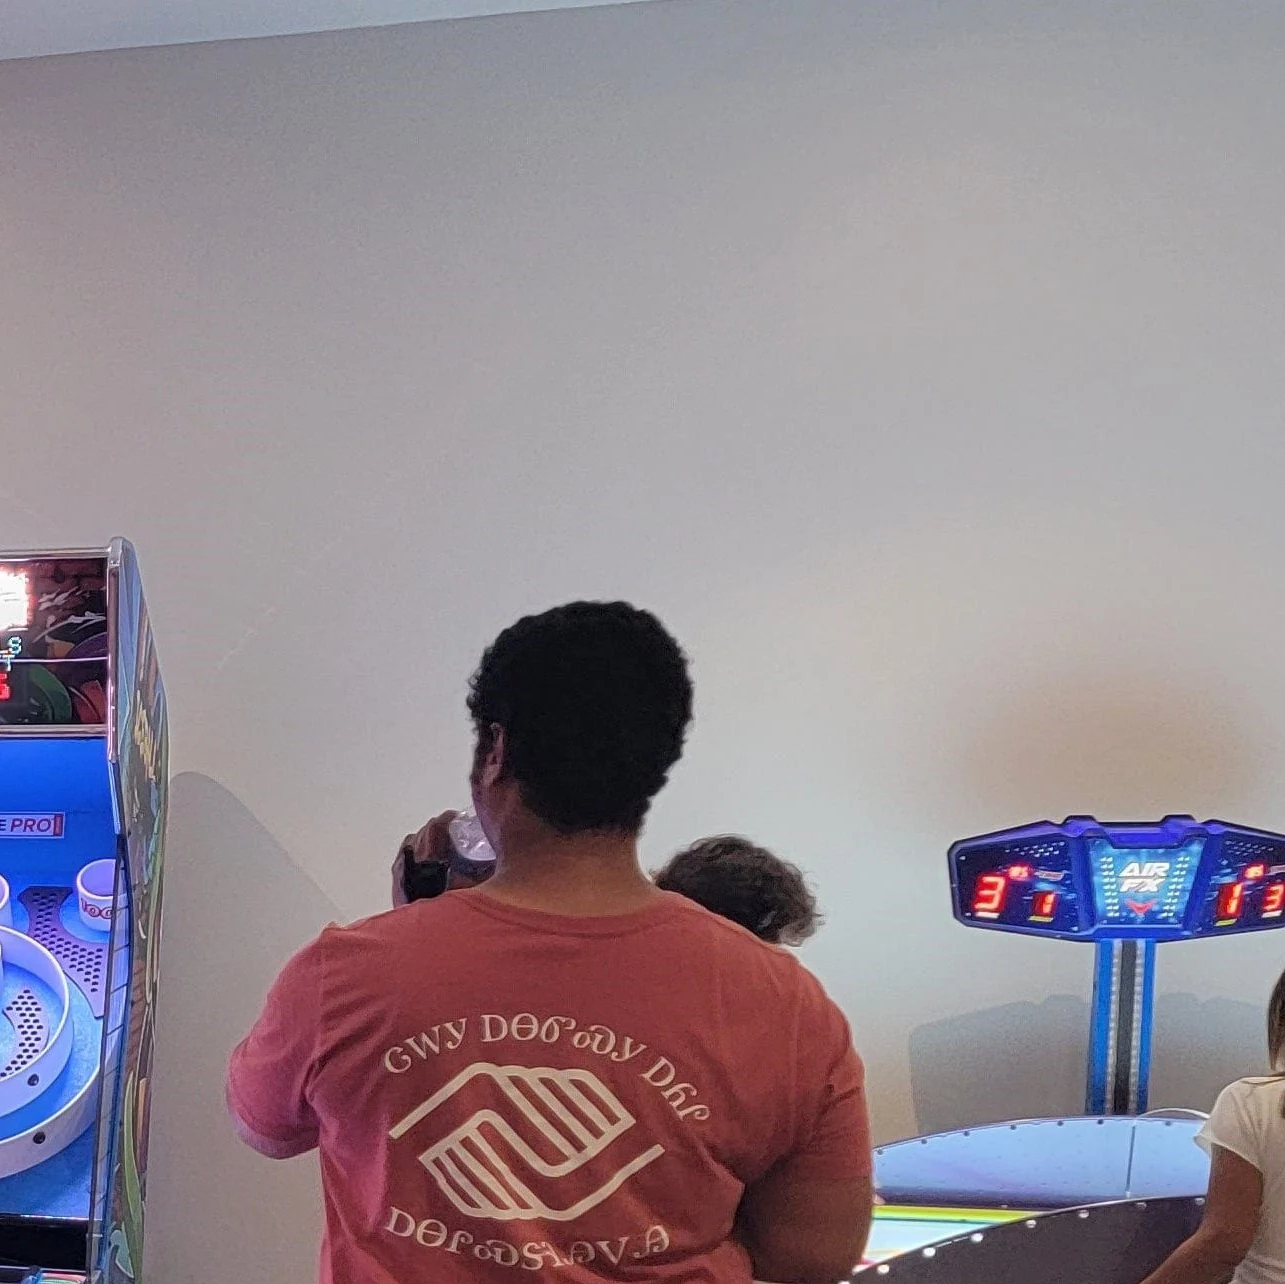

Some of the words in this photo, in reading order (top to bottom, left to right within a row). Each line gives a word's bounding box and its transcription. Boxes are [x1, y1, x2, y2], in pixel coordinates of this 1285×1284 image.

[10, 818, 51, 832] PRO
[1118, 862, 1170, 877] AIR
[974, 876, 1006, 909] 3
[1119, 878, 1166, 893] FX
[1263, 884, 1285, 912] 3
[81, 897, 113, 920] 100
